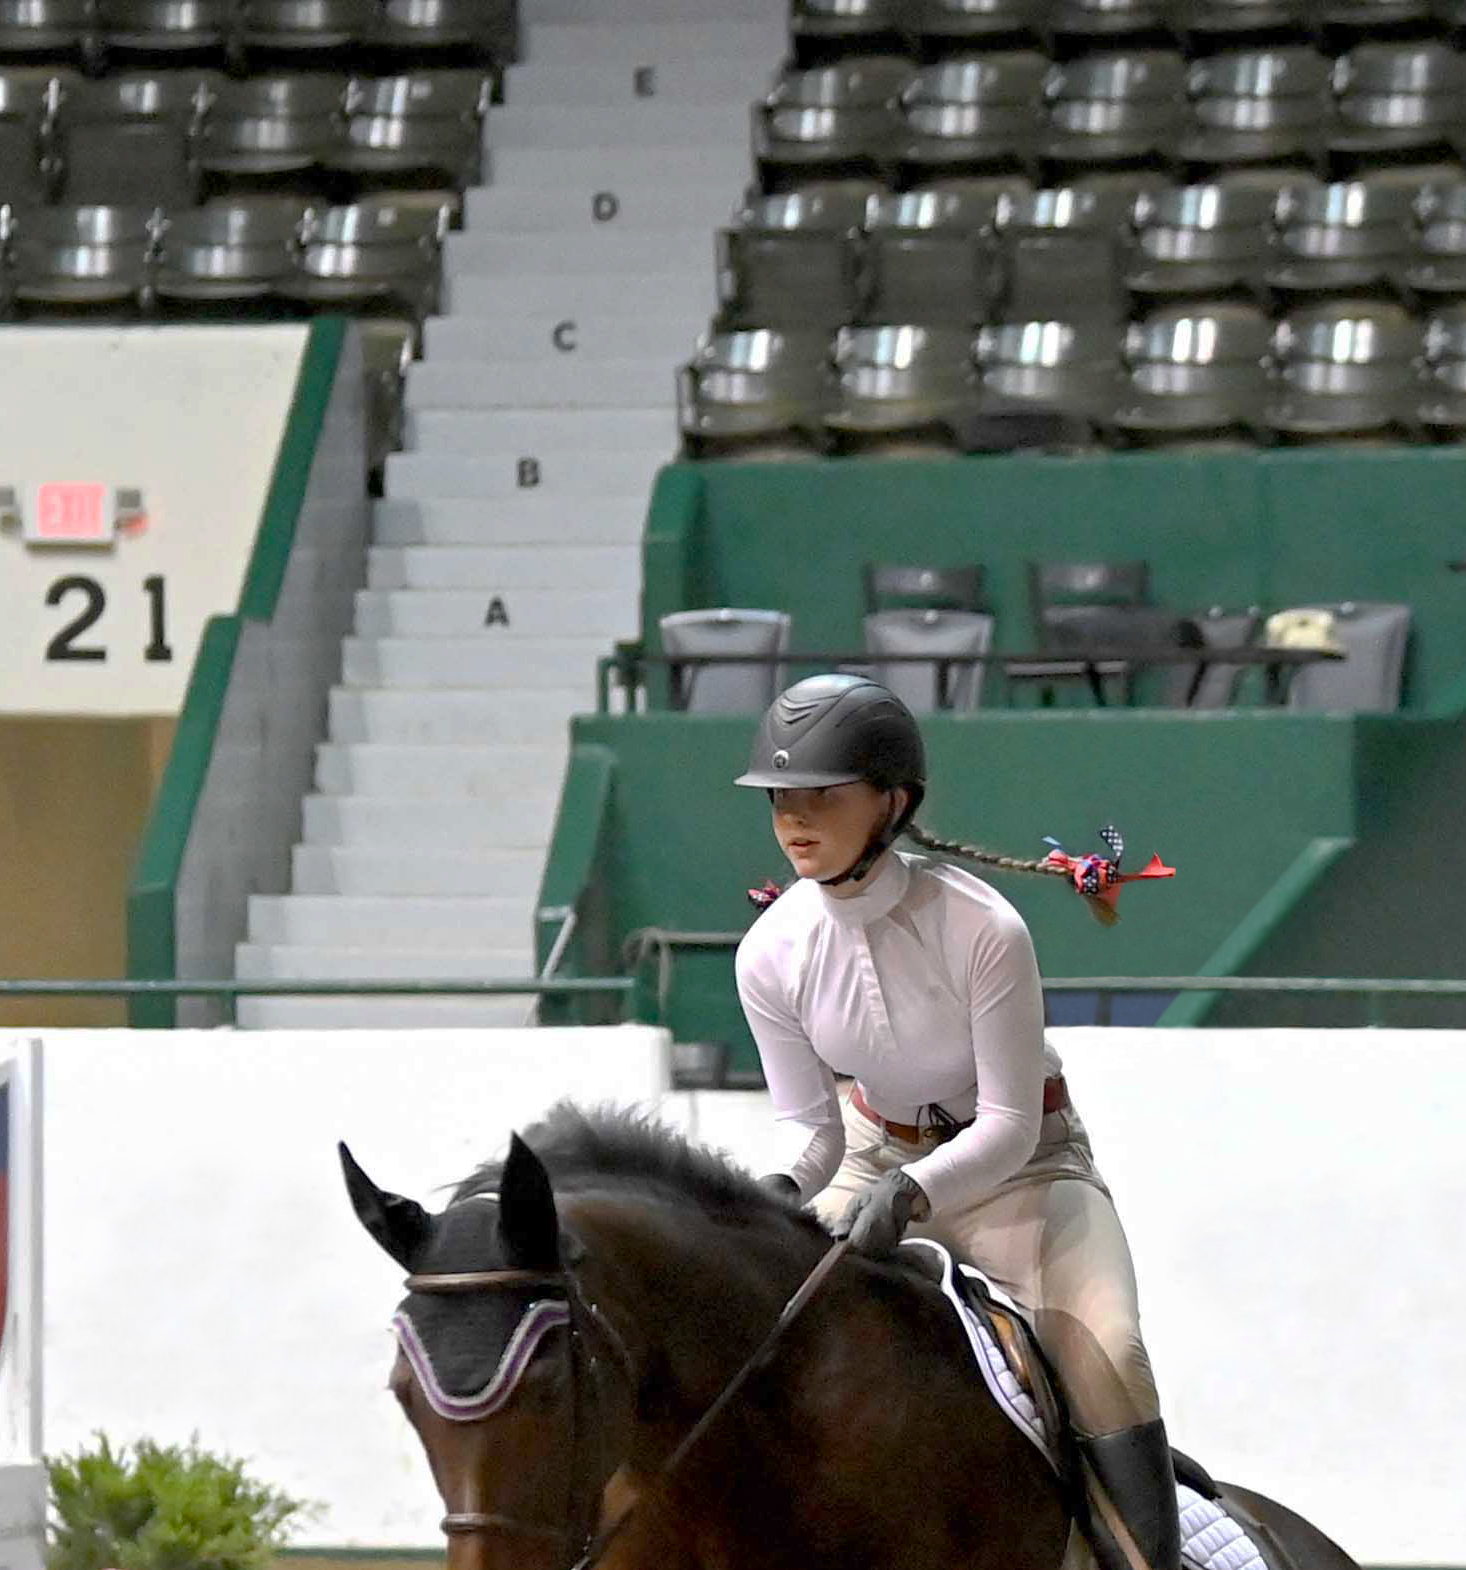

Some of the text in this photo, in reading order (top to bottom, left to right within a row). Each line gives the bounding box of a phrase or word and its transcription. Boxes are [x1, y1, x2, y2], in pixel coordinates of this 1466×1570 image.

[552, 321, 576, 352] C
[517, 458, 540, 488] B
[46, 575, 173, 662] 21
[485, 598, 509, 627] A
